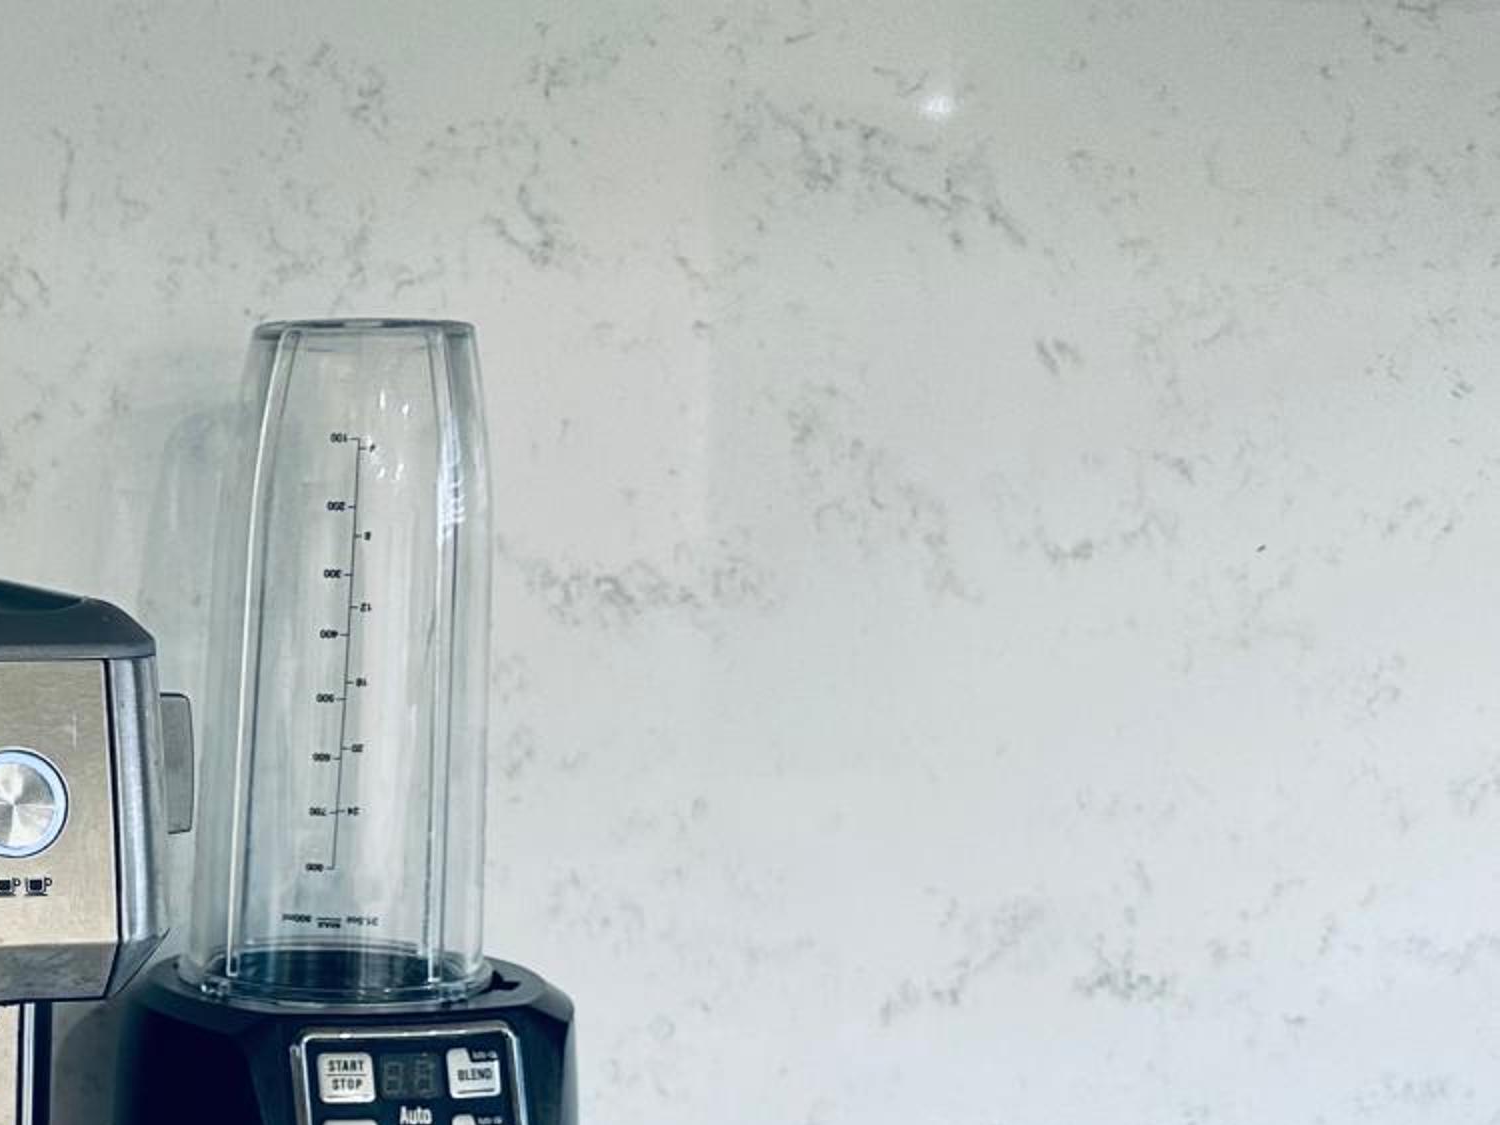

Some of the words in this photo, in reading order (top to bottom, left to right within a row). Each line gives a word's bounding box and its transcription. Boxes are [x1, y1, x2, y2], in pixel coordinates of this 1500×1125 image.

[328, 1060, 365, 1072] START
[457, 1068, 493, 1081] BLEND
[331, 1078, 363, 1090] STOP
[400, 1105, 432, 1125] Auto
